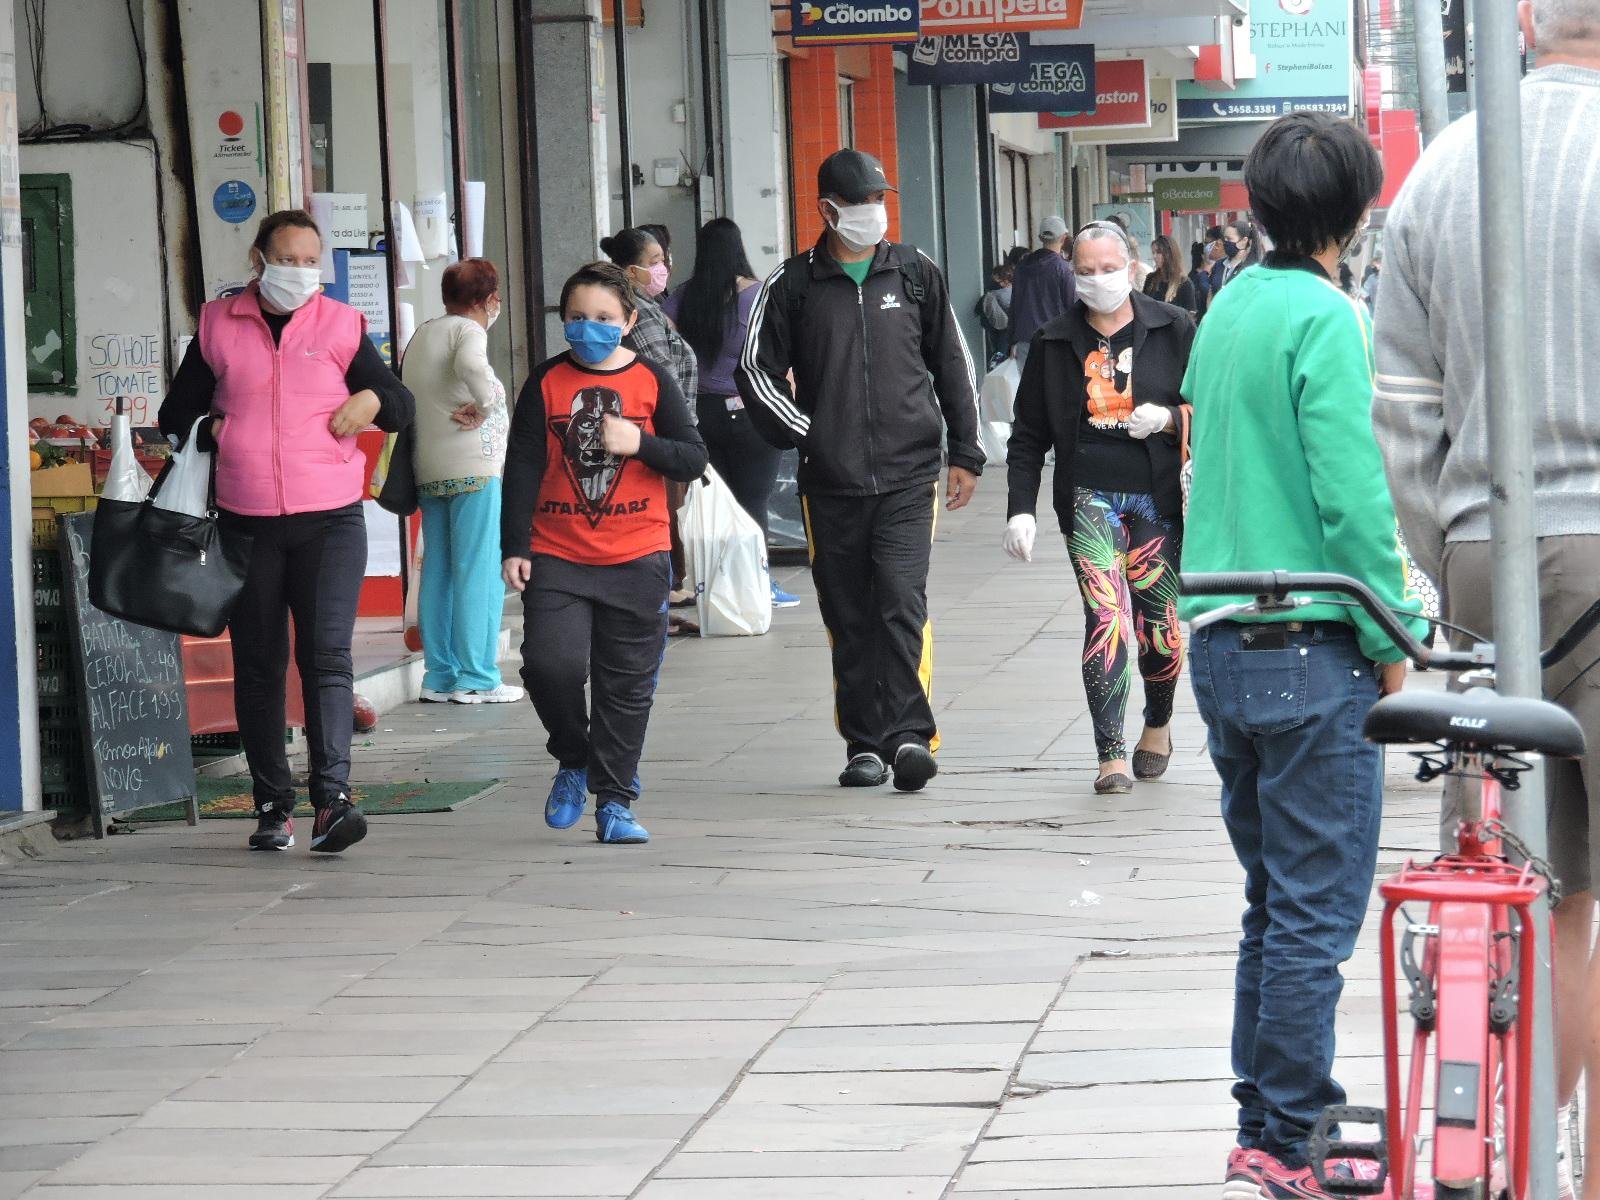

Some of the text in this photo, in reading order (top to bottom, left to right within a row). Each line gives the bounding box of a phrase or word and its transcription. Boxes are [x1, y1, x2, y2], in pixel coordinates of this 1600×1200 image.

[823, 4, 912, 23] Colombo
[1250, 21, 1346, 38] STEPHANI
[945, 32, 1017, 48] MEGA
[944, 48, 1018, 64] compra
[1020, 79, 1085, 95] compra
[1227, 104, 1277, 115] 3458.3381
[219, 144, 246, 153] Ticket
[123, 335, 160, 367] HOJE
[91, 371, 160, 396] TOMATE
[540, 498, 650, 516] STAR WARS
[81, 620, 129, 657] BATATA
[85, 648, 150, 689] CEBOLA
[91, 689, 149, 731] ALFACE
